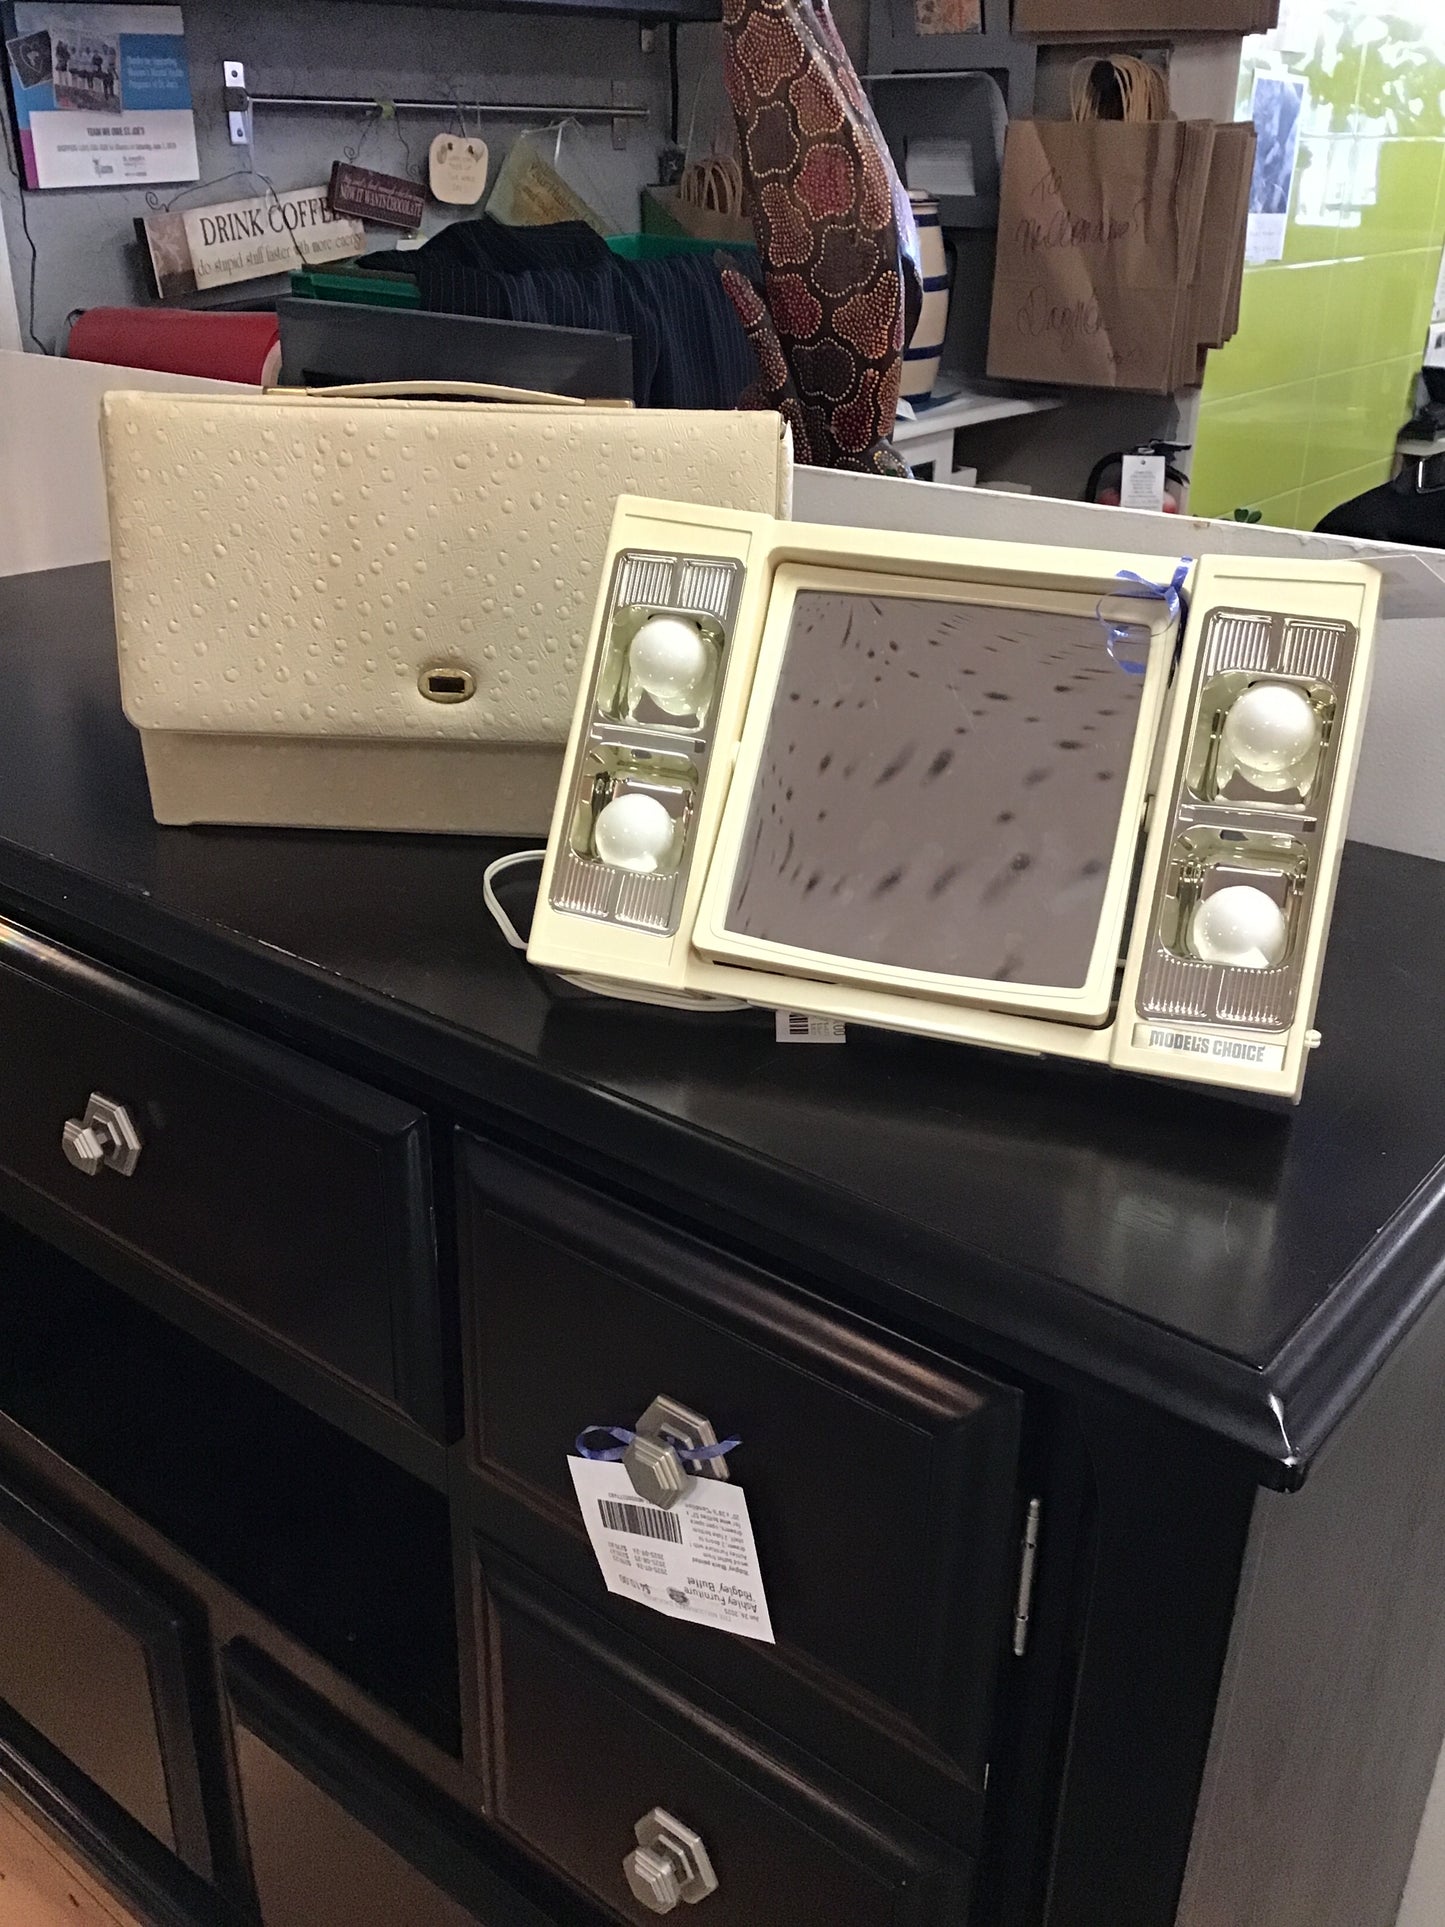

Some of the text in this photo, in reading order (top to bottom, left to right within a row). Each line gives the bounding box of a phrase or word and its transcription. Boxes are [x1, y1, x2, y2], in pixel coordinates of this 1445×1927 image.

[341, 183, 423, 217] NOW IT WANTS CHOCOLATE
[200, 208, 264, 246] DRINK
[198, 258, 211, 277] do
[214, 254, 243, 276] stupid
[246, 248, 265, 264] stuff
[266, 243, 291, 262] faster
[312, 238, 332, 251] more
[335, 232, 364, 250] energy
[1150, 1030, 1266, 1062] MODEL'S CHOICE
[684, 1586, 757, 1613] Ashley Furniture
[686, 1576, 715, 1591] Buffet
